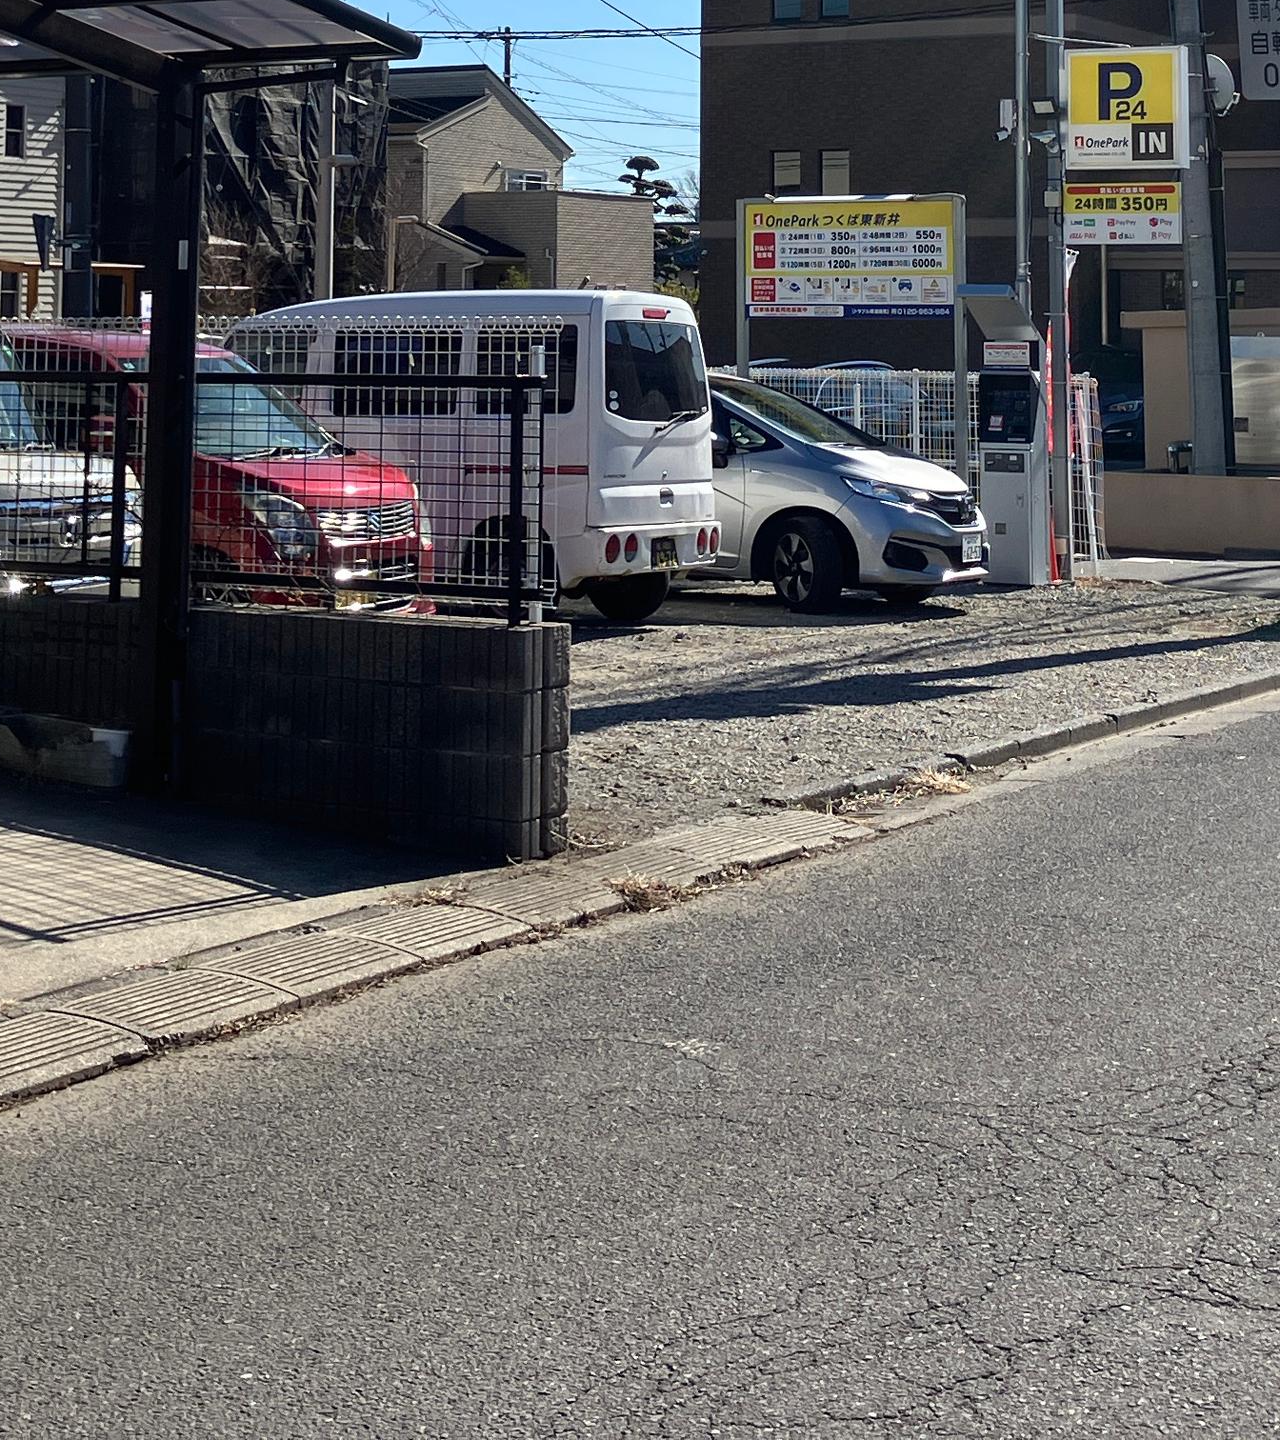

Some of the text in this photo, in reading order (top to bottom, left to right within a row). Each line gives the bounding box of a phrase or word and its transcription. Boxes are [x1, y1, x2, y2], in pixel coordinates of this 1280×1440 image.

[1264, 62, 1279, 88] 0
[1098, 62, 1143, 121] P
[1115, 101, 1147, 120] 24
[1086, 136, 1129, 149] OnePark
[1138, 131, 1166, 154] IN
[1074, 197, 1167, 211] 24時間 350円
[765, 214, 819, 227] OnePark
[822, 212, 900, 226] つくば東新井
[831, 232, 856, 241] 350円
[915, 230, 942, 240] 550円
[831, 246, 856, 255] 800円
[912, 244, 942, 253] 1000円
[827, 260, 856, 269] 1200円
[912, 259, 942, 268] 6000円
